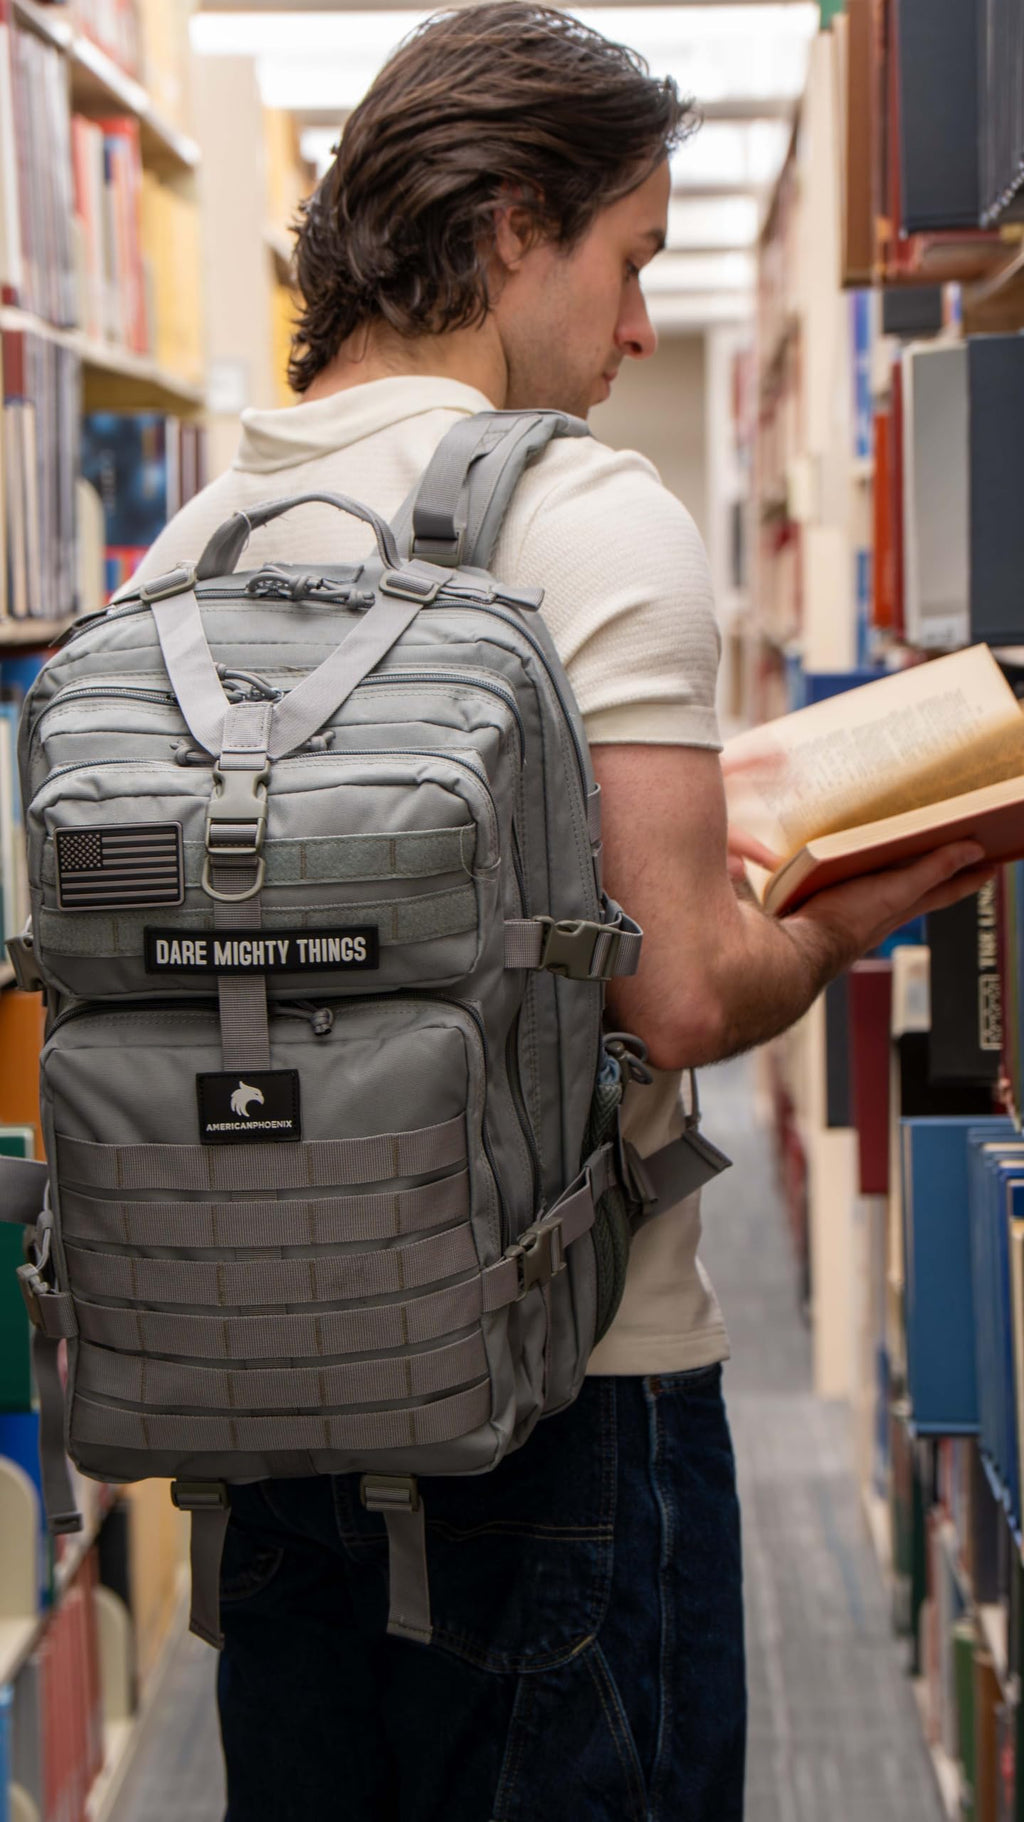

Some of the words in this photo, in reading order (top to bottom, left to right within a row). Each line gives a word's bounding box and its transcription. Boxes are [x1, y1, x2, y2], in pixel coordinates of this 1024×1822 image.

[156, 939, 207, 965] DARE
[214, 940, 289, 966] MIGHTY
[296, 936, 367, 963] THINGS
[206, 1120, 293, 1132] AMERICANPHOENIX
